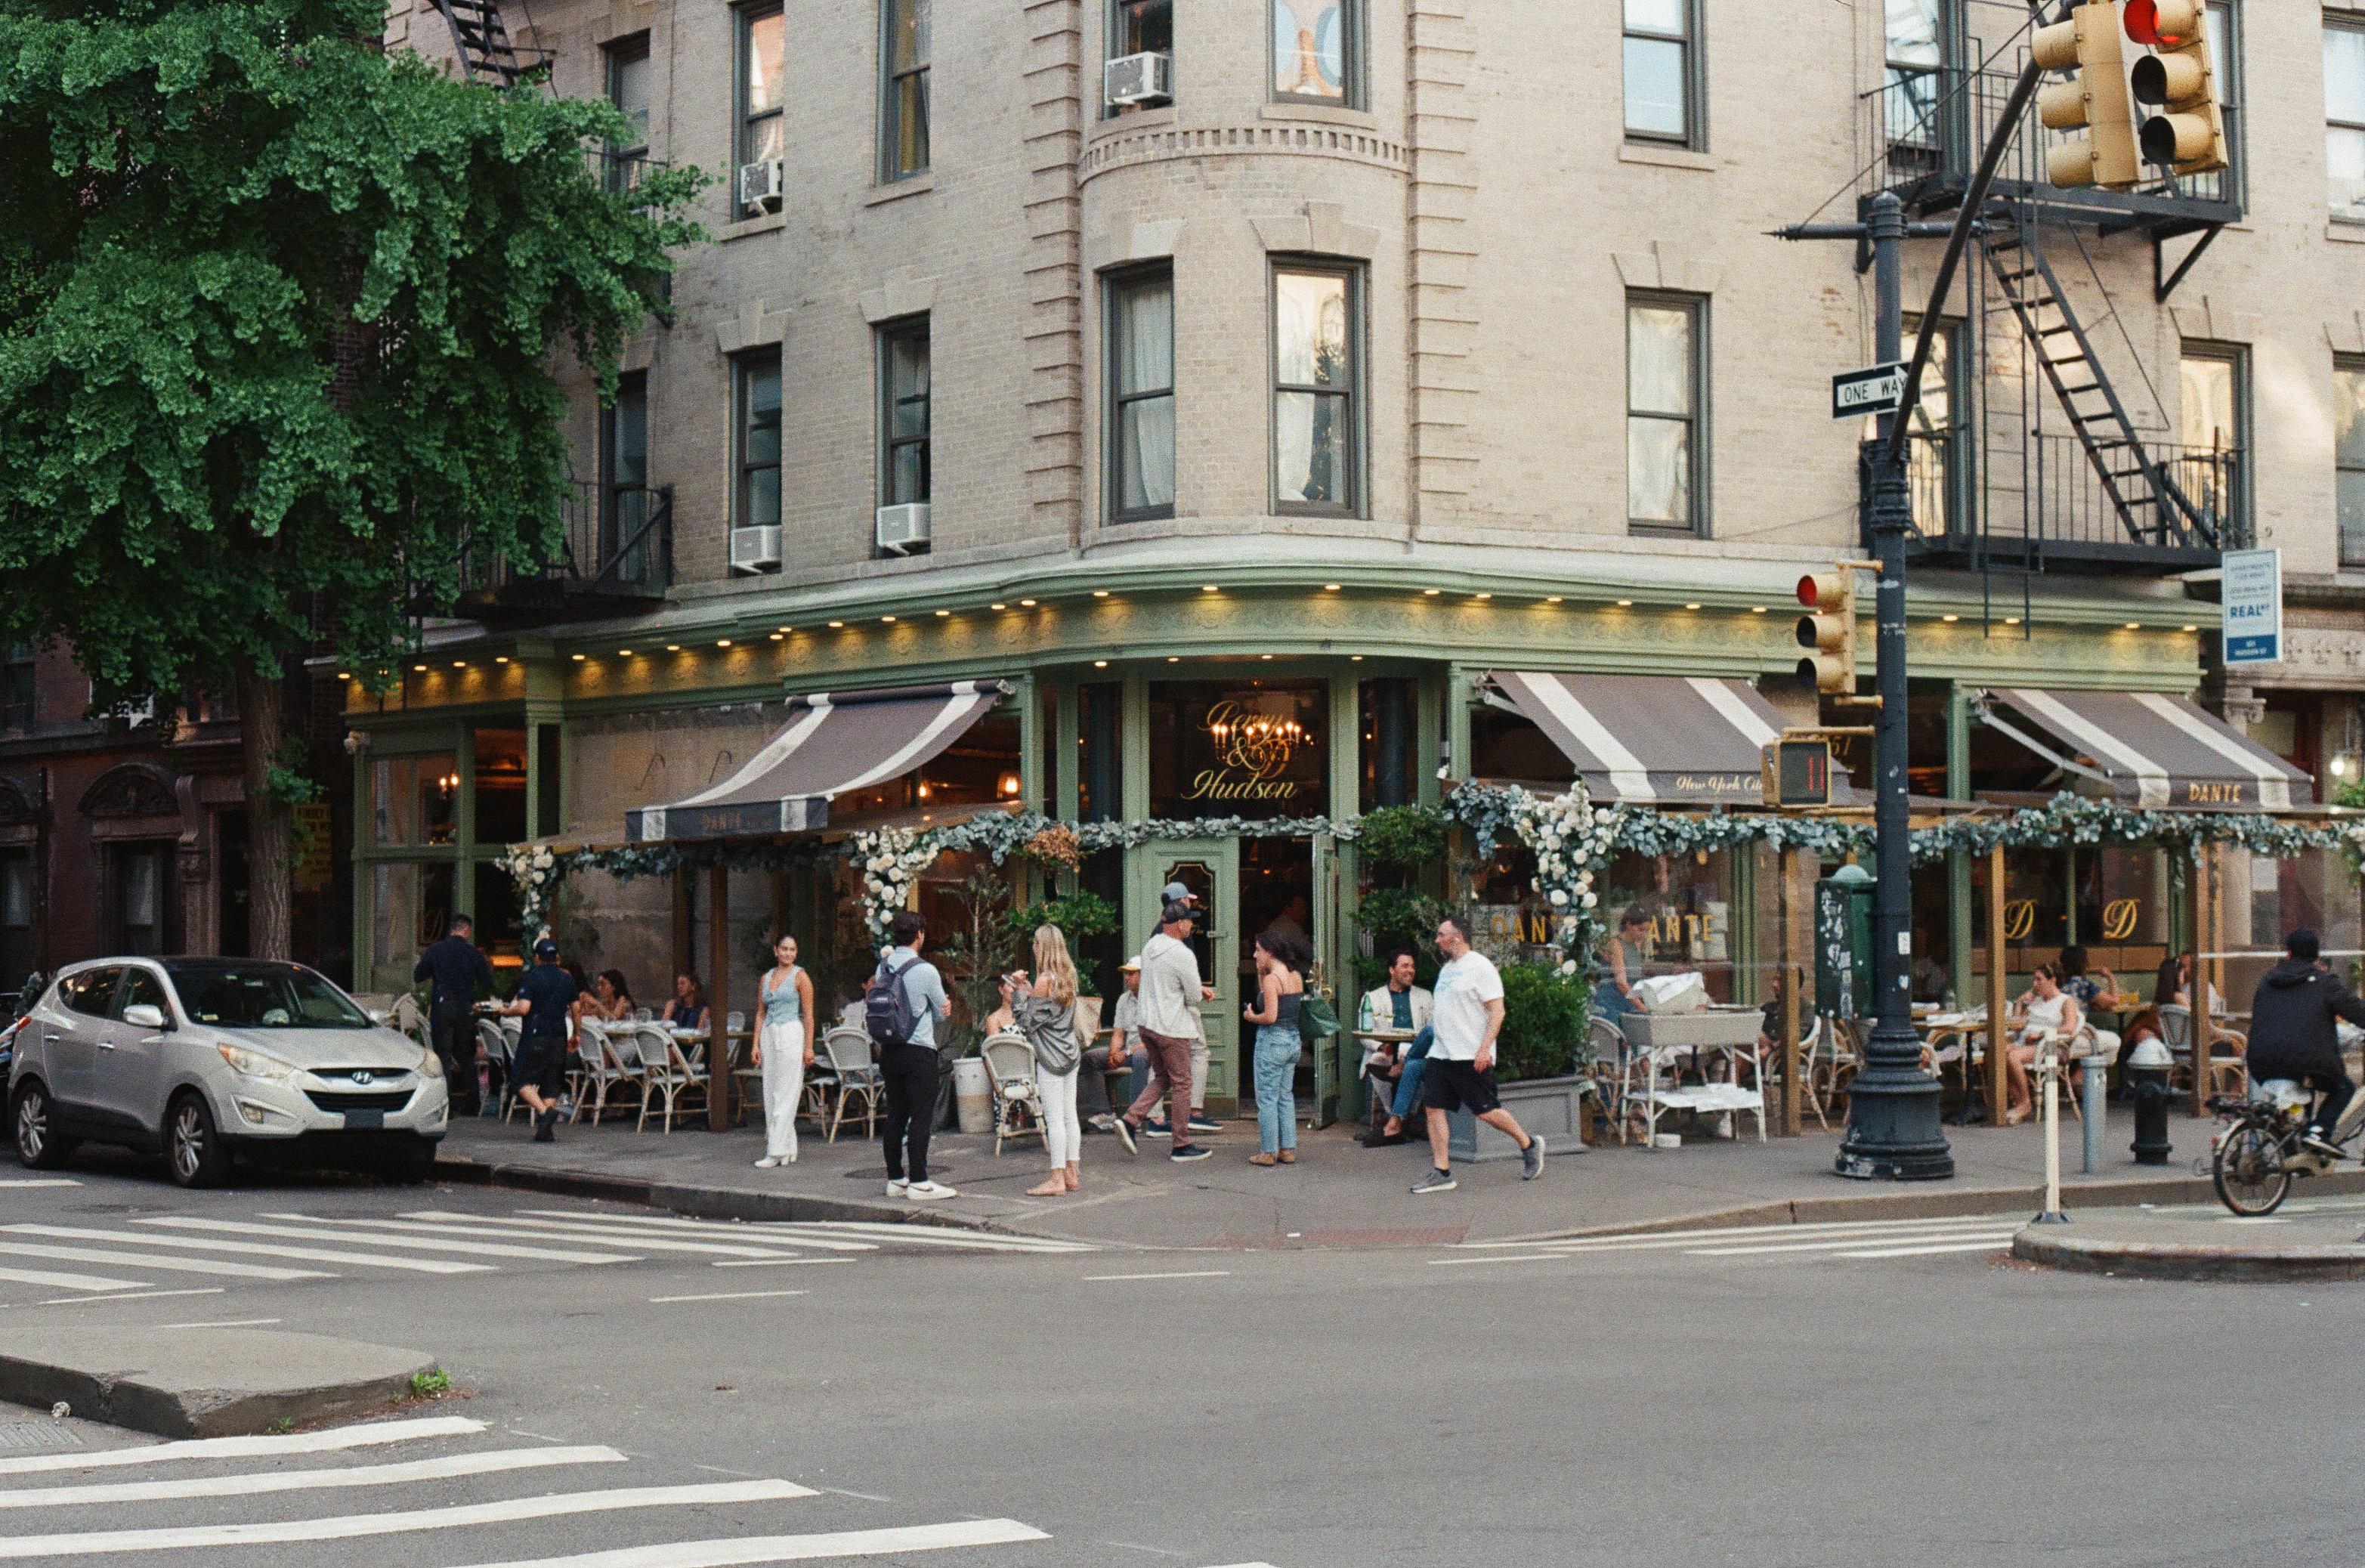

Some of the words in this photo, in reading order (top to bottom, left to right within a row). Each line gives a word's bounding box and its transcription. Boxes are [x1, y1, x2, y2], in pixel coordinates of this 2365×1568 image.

[1844, 383, 1869, 403] ONE
[1881, 376, 1906, 397] WAY
[2230, 605, 2262, 617] REAL
[1226, 737, 1266, 771] &
[1180, 769, 1298, 800] Hudson
[1676, 775, 1705, 791] New
[1708, 775, 1740, 794] York
[1744, 775, 1763, 790] Cit
[2189, 782, 2243, 803] DANTE
[1646, 914, 1714, 943] ANTE
[2104, 898, 2141, 939] D
